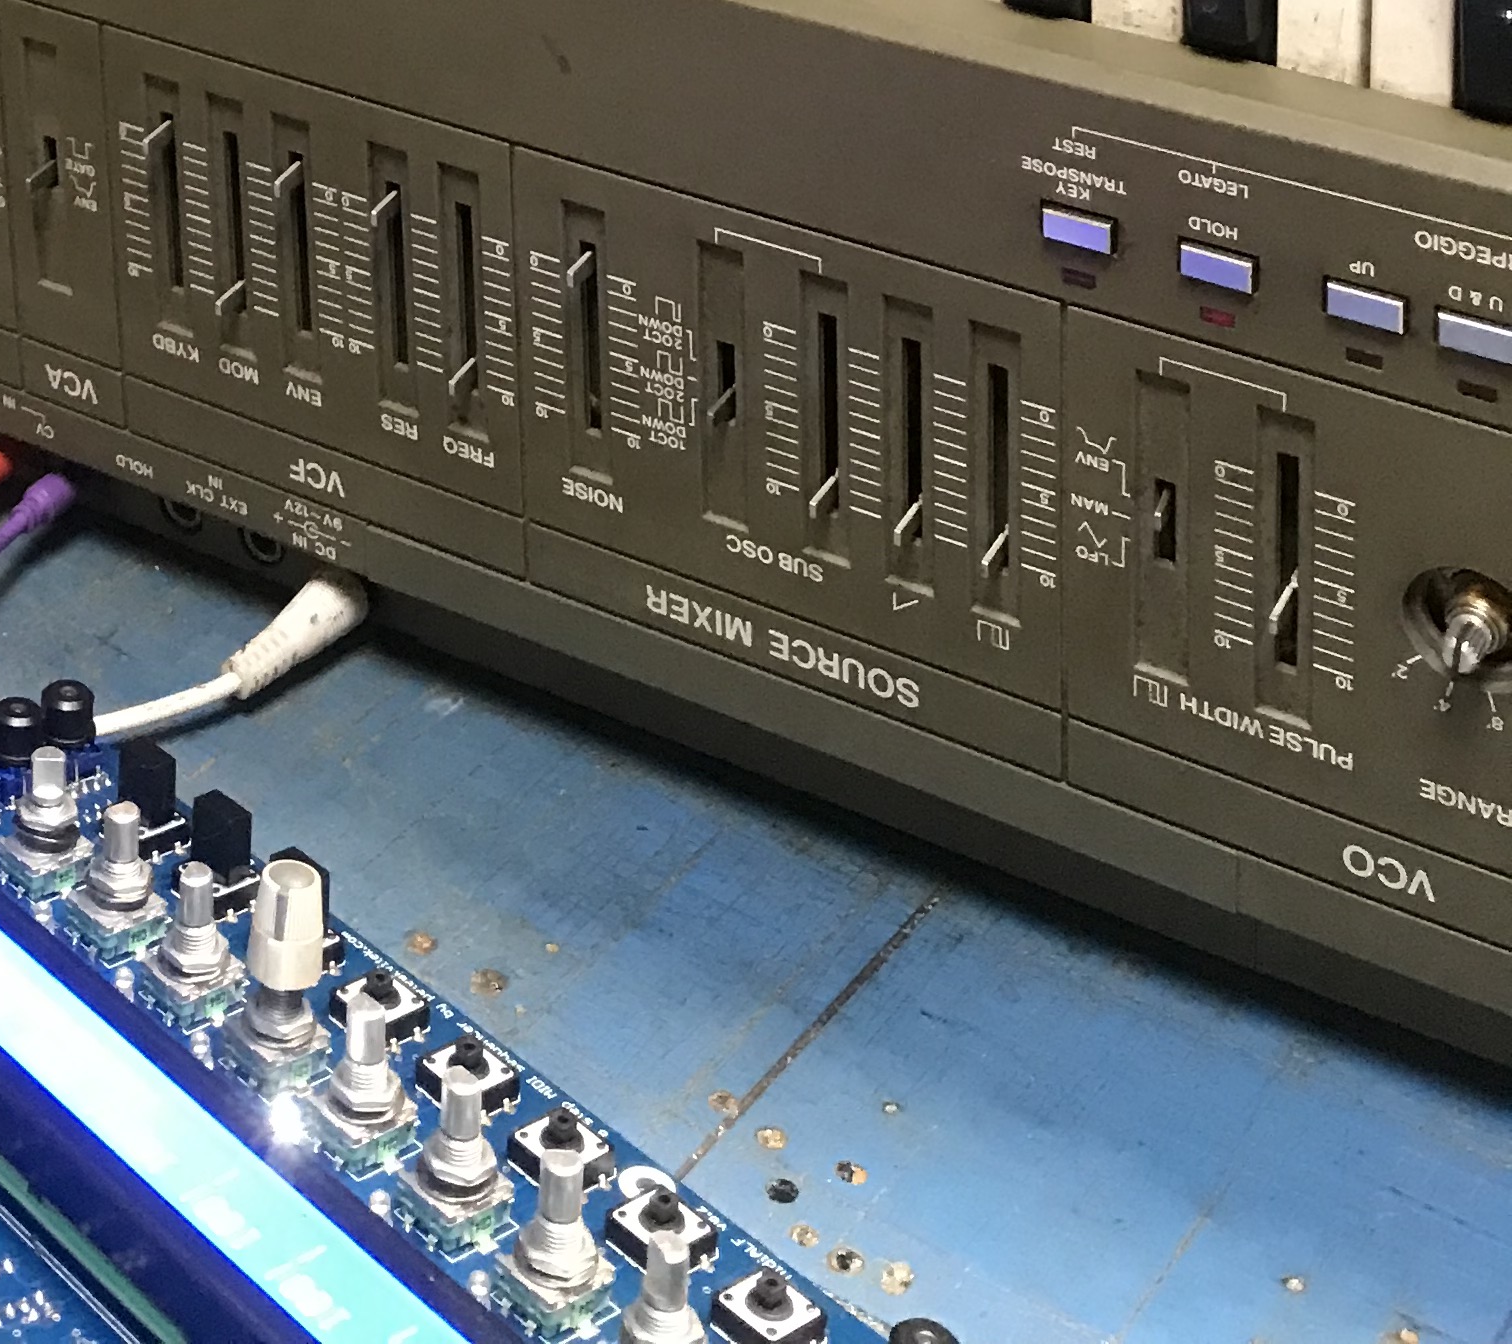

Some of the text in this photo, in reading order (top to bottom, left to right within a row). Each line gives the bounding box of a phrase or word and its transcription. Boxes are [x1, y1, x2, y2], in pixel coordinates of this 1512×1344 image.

[1051, 137, 1096, 160] REST
[1021, 155, 1127, 196] TRANSPOSE
[1178, 169, 1249, 199] LEGATO
[1055, 180, 1090, 201] KEY
[1188, 216, 1238, 241] HOLD
[1348, 260, 1375, 277] UP
[1448, 285, 1503, 313] U & D
[638, 313, 683, 337] DOWN
[152, 333, 200, 363] KYBD
[44, 363, 98, 405] VCA
[218, 357, 260, 385] MOD
[640, 365, 685, 390] DOWN
[285, 381, 322, 407] ENV
[380, 413, 418, 441] RES
[638, 414, 687, 438] DOWN
[443, 435, 495, 469] FREQ
[1074, 450, 1110, 473] ENV
[115, 454, 154, 479] HOLD
[289, 458, 345, 498] VCF
[207, 474, 223, 491] IN
[561, 477, 624, 514] NOISE
[185, 480, 248, 516] EXT CLK
[1070, 493, 1109, 516] MAN
[292, 532, 337, 561] DC IN
[726, 534, 824, 583] SUB OSC
[1075, 545, 1109, 566] LFO
[1039, 574, 1056, 589] 10
[646, 584, 920, 708] SOURCE MIXER
[1214, 633, 1235, 649] 10
[1335, 675, 1354, 691] 10
[1179, 692, 1353, 771] PULSE WIDTH
[1419, 777, 1512, 828] RANGE
[1342, 844, 1436, 903] VCO
[435, 1003, 455, 1019] by
[525, 1075, 558, 1100] MIDI
